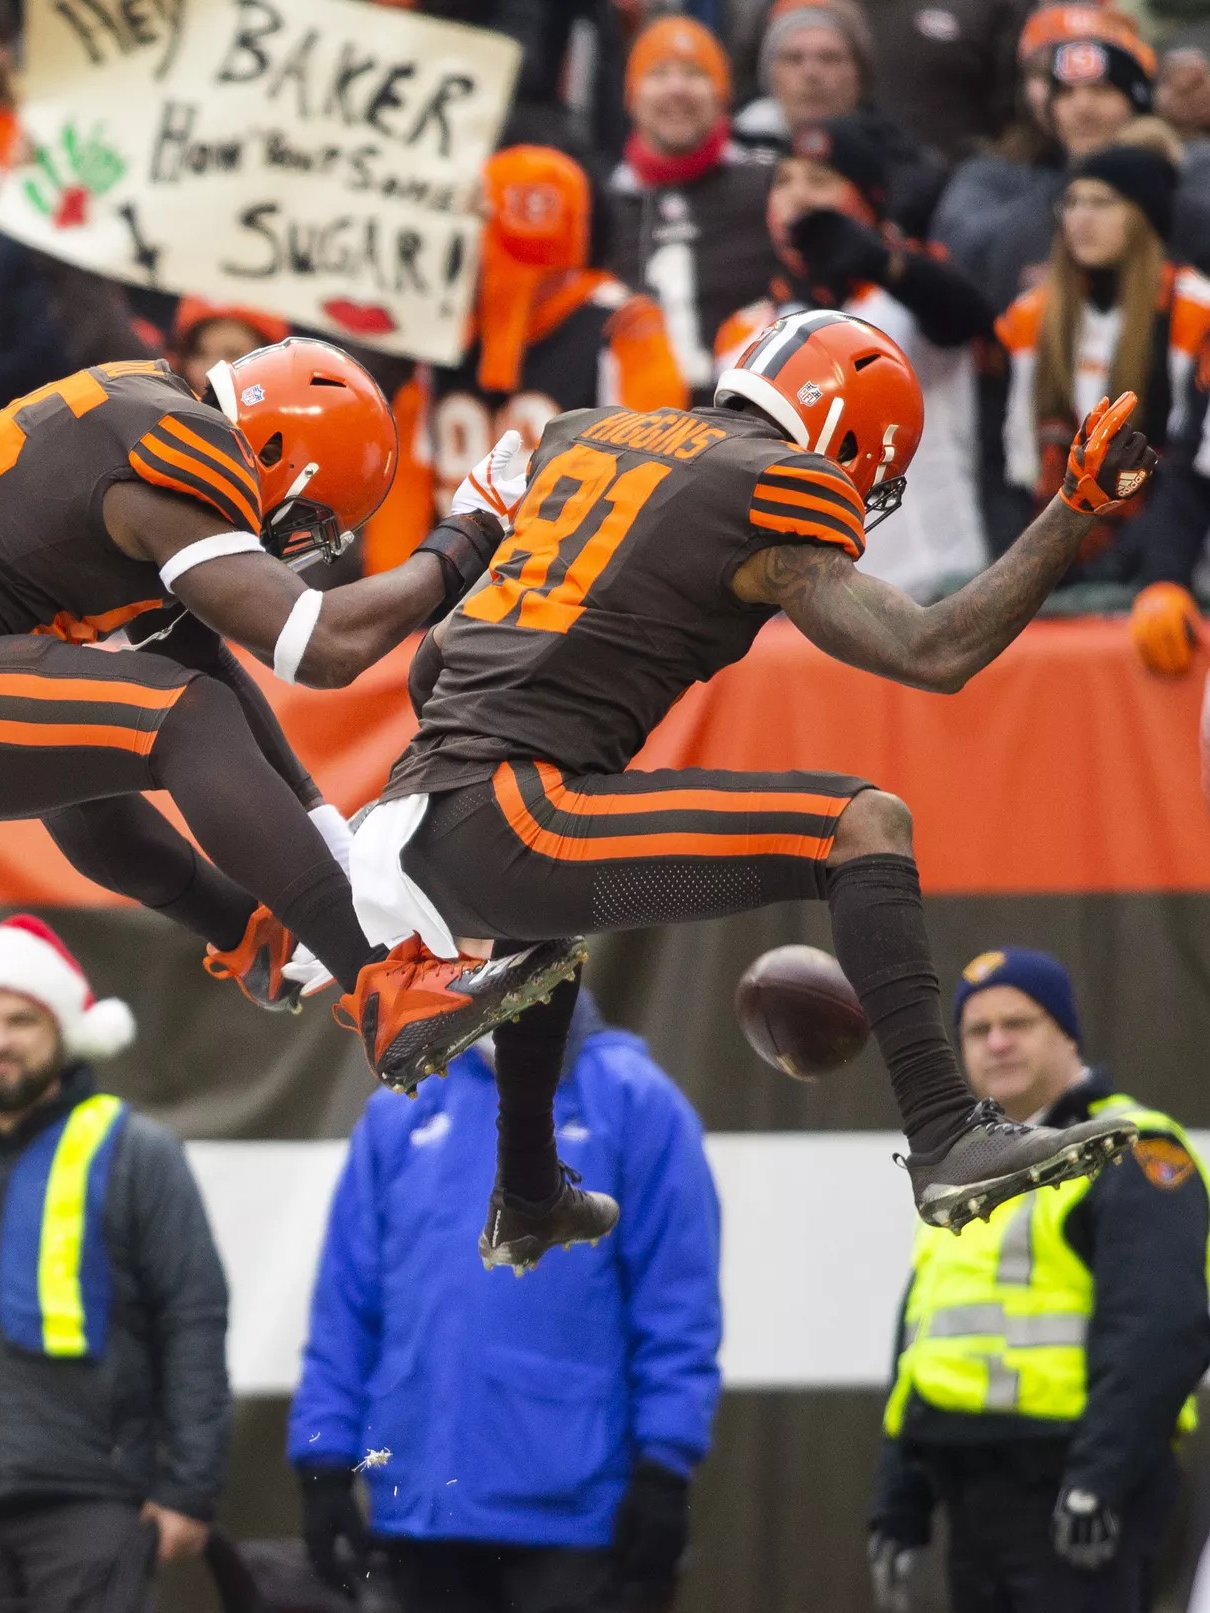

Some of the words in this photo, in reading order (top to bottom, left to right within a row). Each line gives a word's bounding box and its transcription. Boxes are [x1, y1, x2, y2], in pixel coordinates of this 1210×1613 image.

[216, 0, 475, 157] BAKER
[580, 411, 727, 460] HIGGINS
[1117, 470, 1146, 498] adidas
[462, 442, 673, 635] 81
